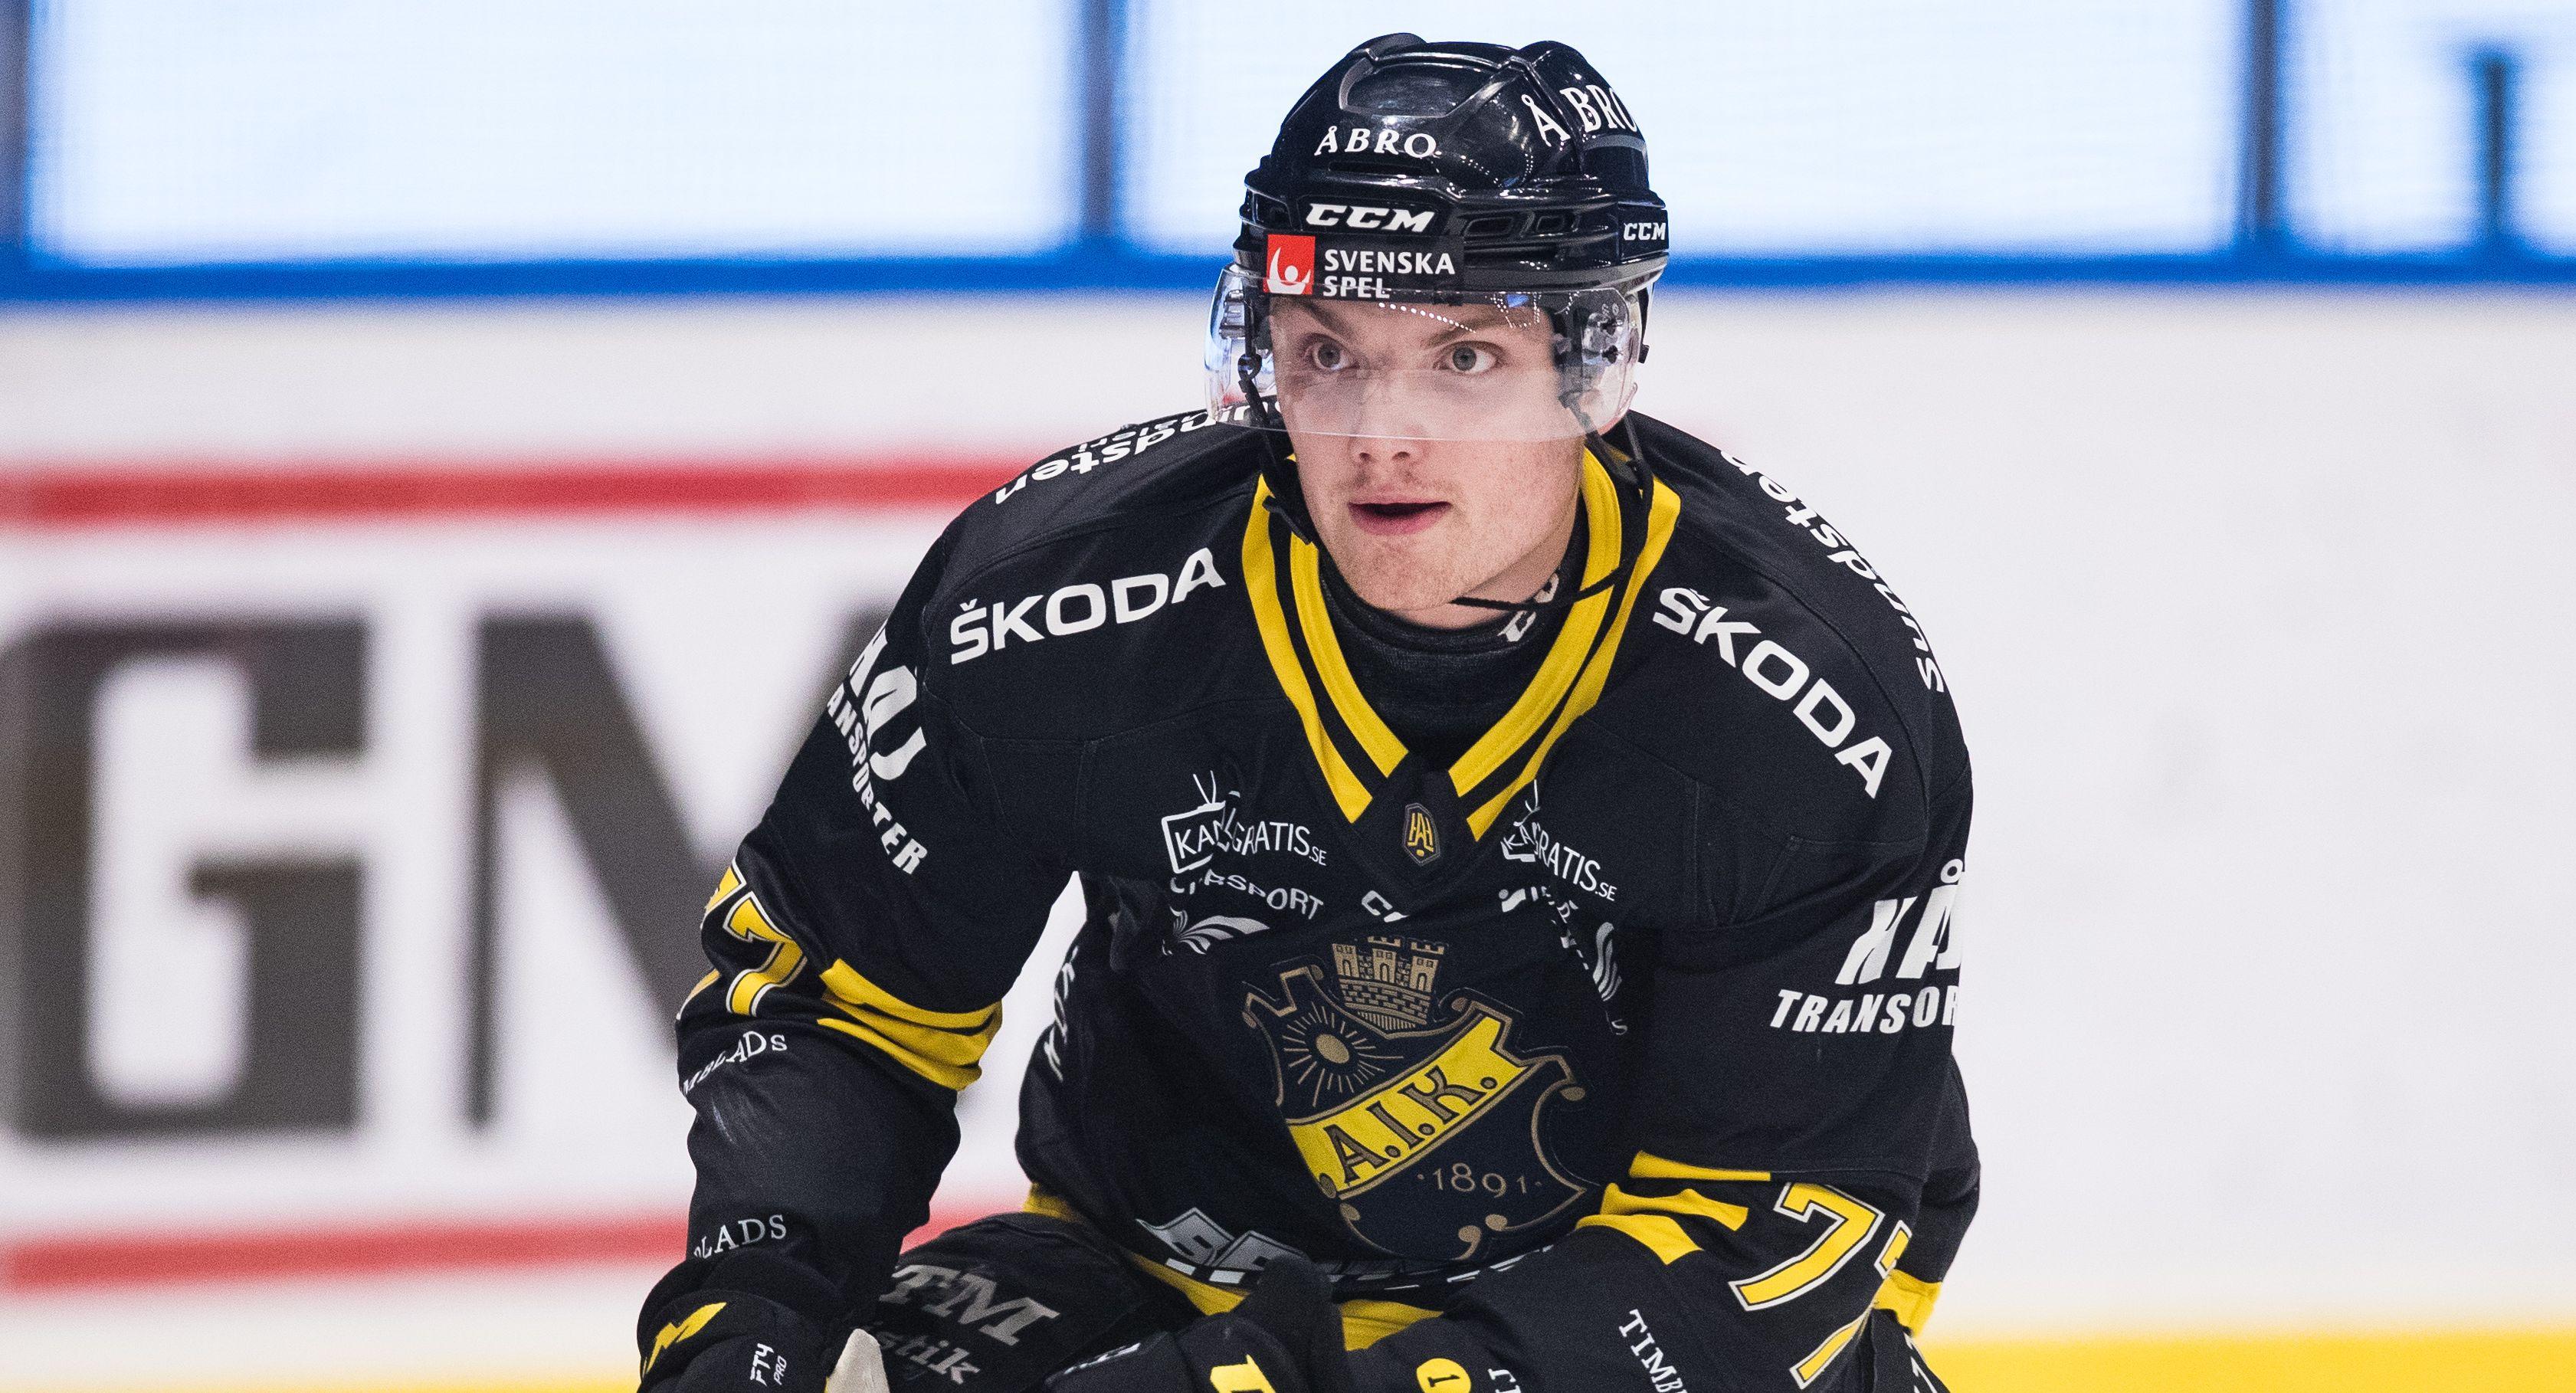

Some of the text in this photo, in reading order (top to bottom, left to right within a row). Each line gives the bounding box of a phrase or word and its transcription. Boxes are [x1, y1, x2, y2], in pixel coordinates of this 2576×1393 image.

[1313, 125, 1437, 159] ÅBRO
[1306, 203, 1435, 233] CCM
[1623, 222, 1667, 241] CCM
[1324, 248, 1456, 274] SVENSKA
[1322, 275, 1391, 299] SPEL
[950, 547, 1226, 664] ŠKODA
[1652, 587, 1893, 799] ŠKODA
[1322, 1064, 1499, 1185] A.I.K.
[1432, 1162, 1527, 1198] 1891
[1619, 1309, 1689, 1393] TIMB
[773, 1355, 787, 1385] PRO
